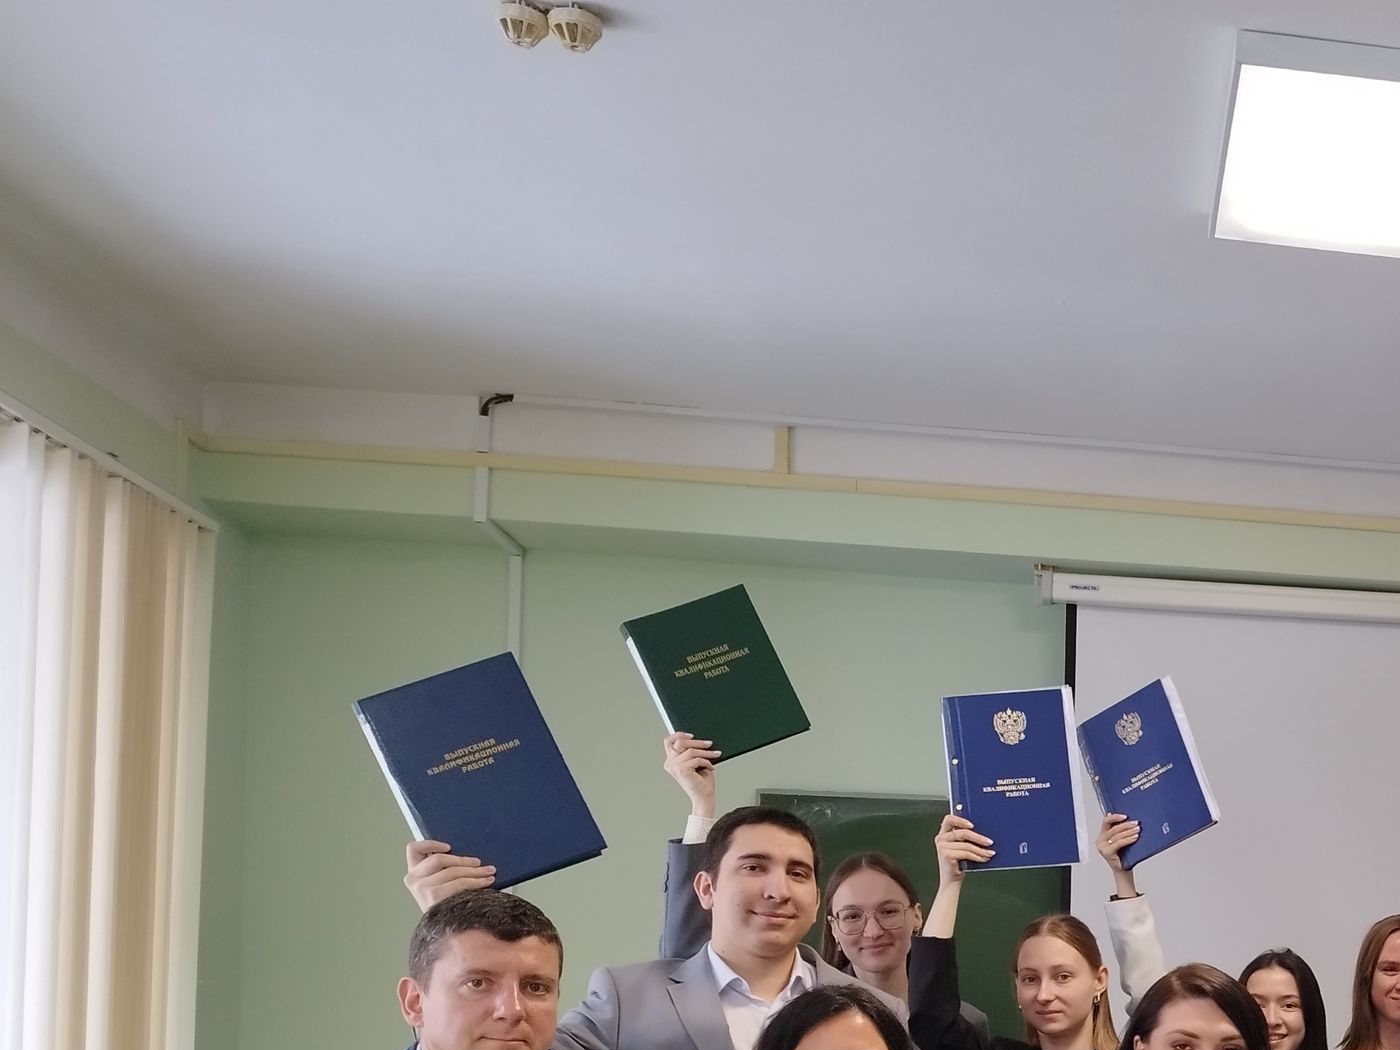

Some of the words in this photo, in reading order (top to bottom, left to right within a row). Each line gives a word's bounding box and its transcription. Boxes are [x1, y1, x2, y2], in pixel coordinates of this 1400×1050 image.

[674, 647, 750, 678] КВАЛИФИКАЦИОННАЯ
[686, 643, 729, 664] ВЫПУСКНАЯ
[704, 665, 730, 680] РАБОТА
[426, 738, 520, 776] КВАЛИФИКАЦИОННАЯ
[443, 738, 496, 761] ВЫПУСКНАЯ
[461, 757, 495, 773] РАБОТА
[996, 777, 1036, 785] ВЫПУСКНАЯ
